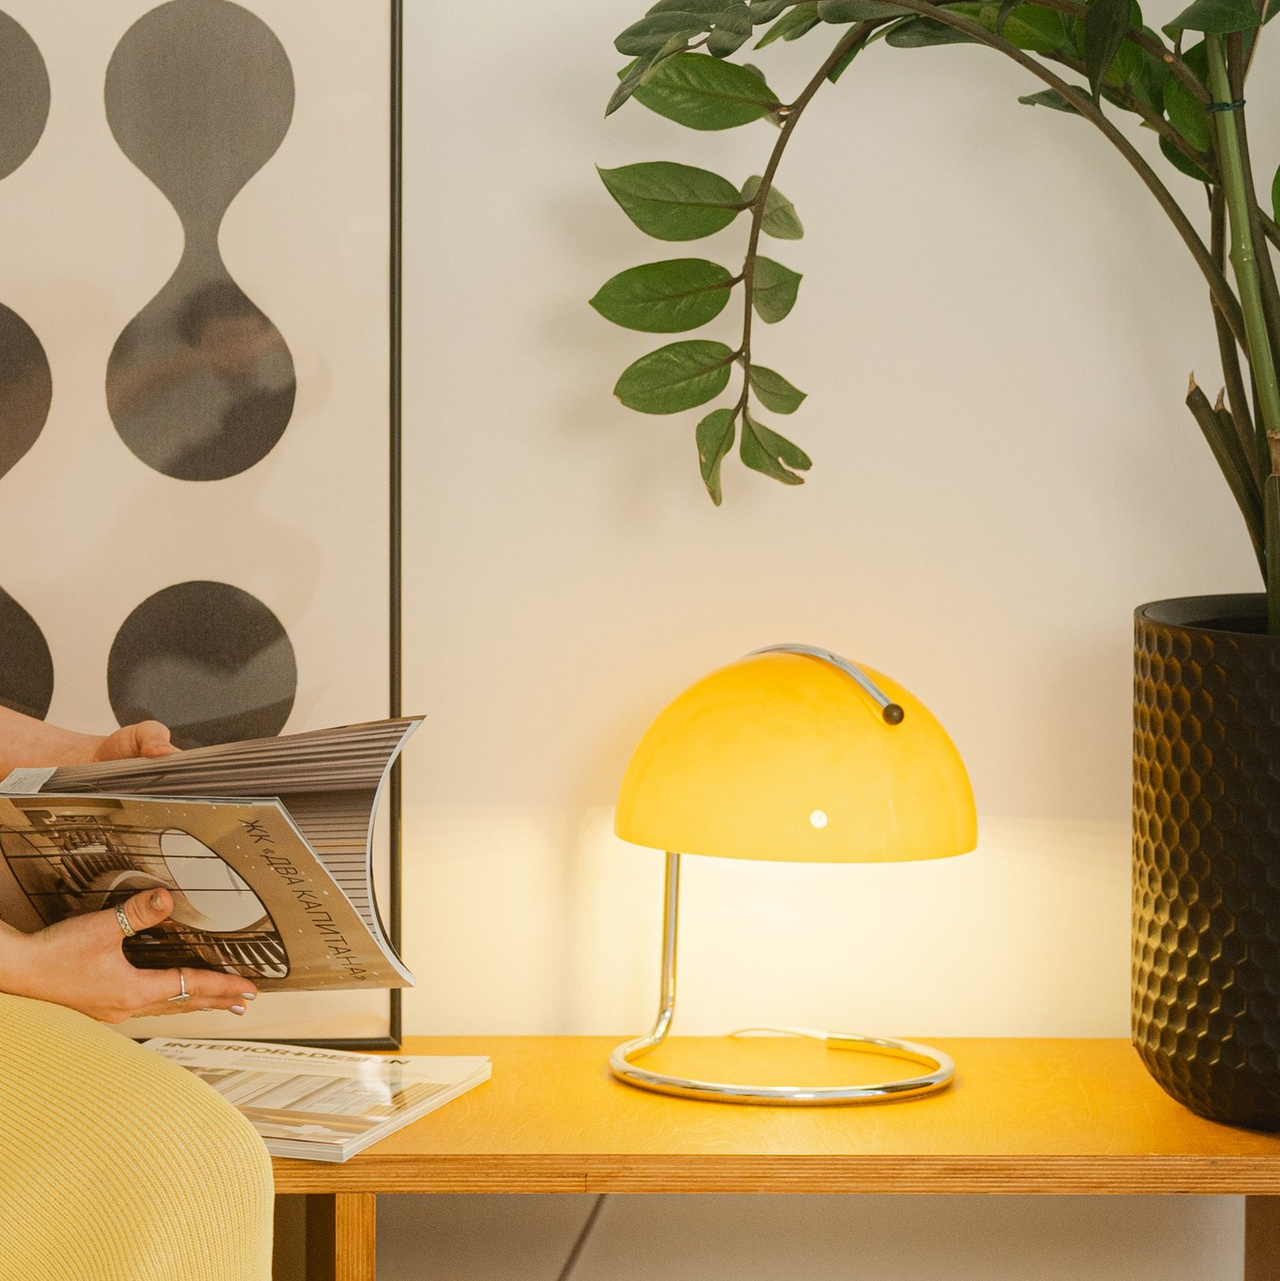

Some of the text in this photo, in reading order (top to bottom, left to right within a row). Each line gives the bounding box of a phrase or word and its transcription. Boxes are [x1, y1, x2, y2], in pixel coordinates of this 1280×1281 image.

[238, 819, 367, 981] ЖК «ДВА КАПИТАНА»
